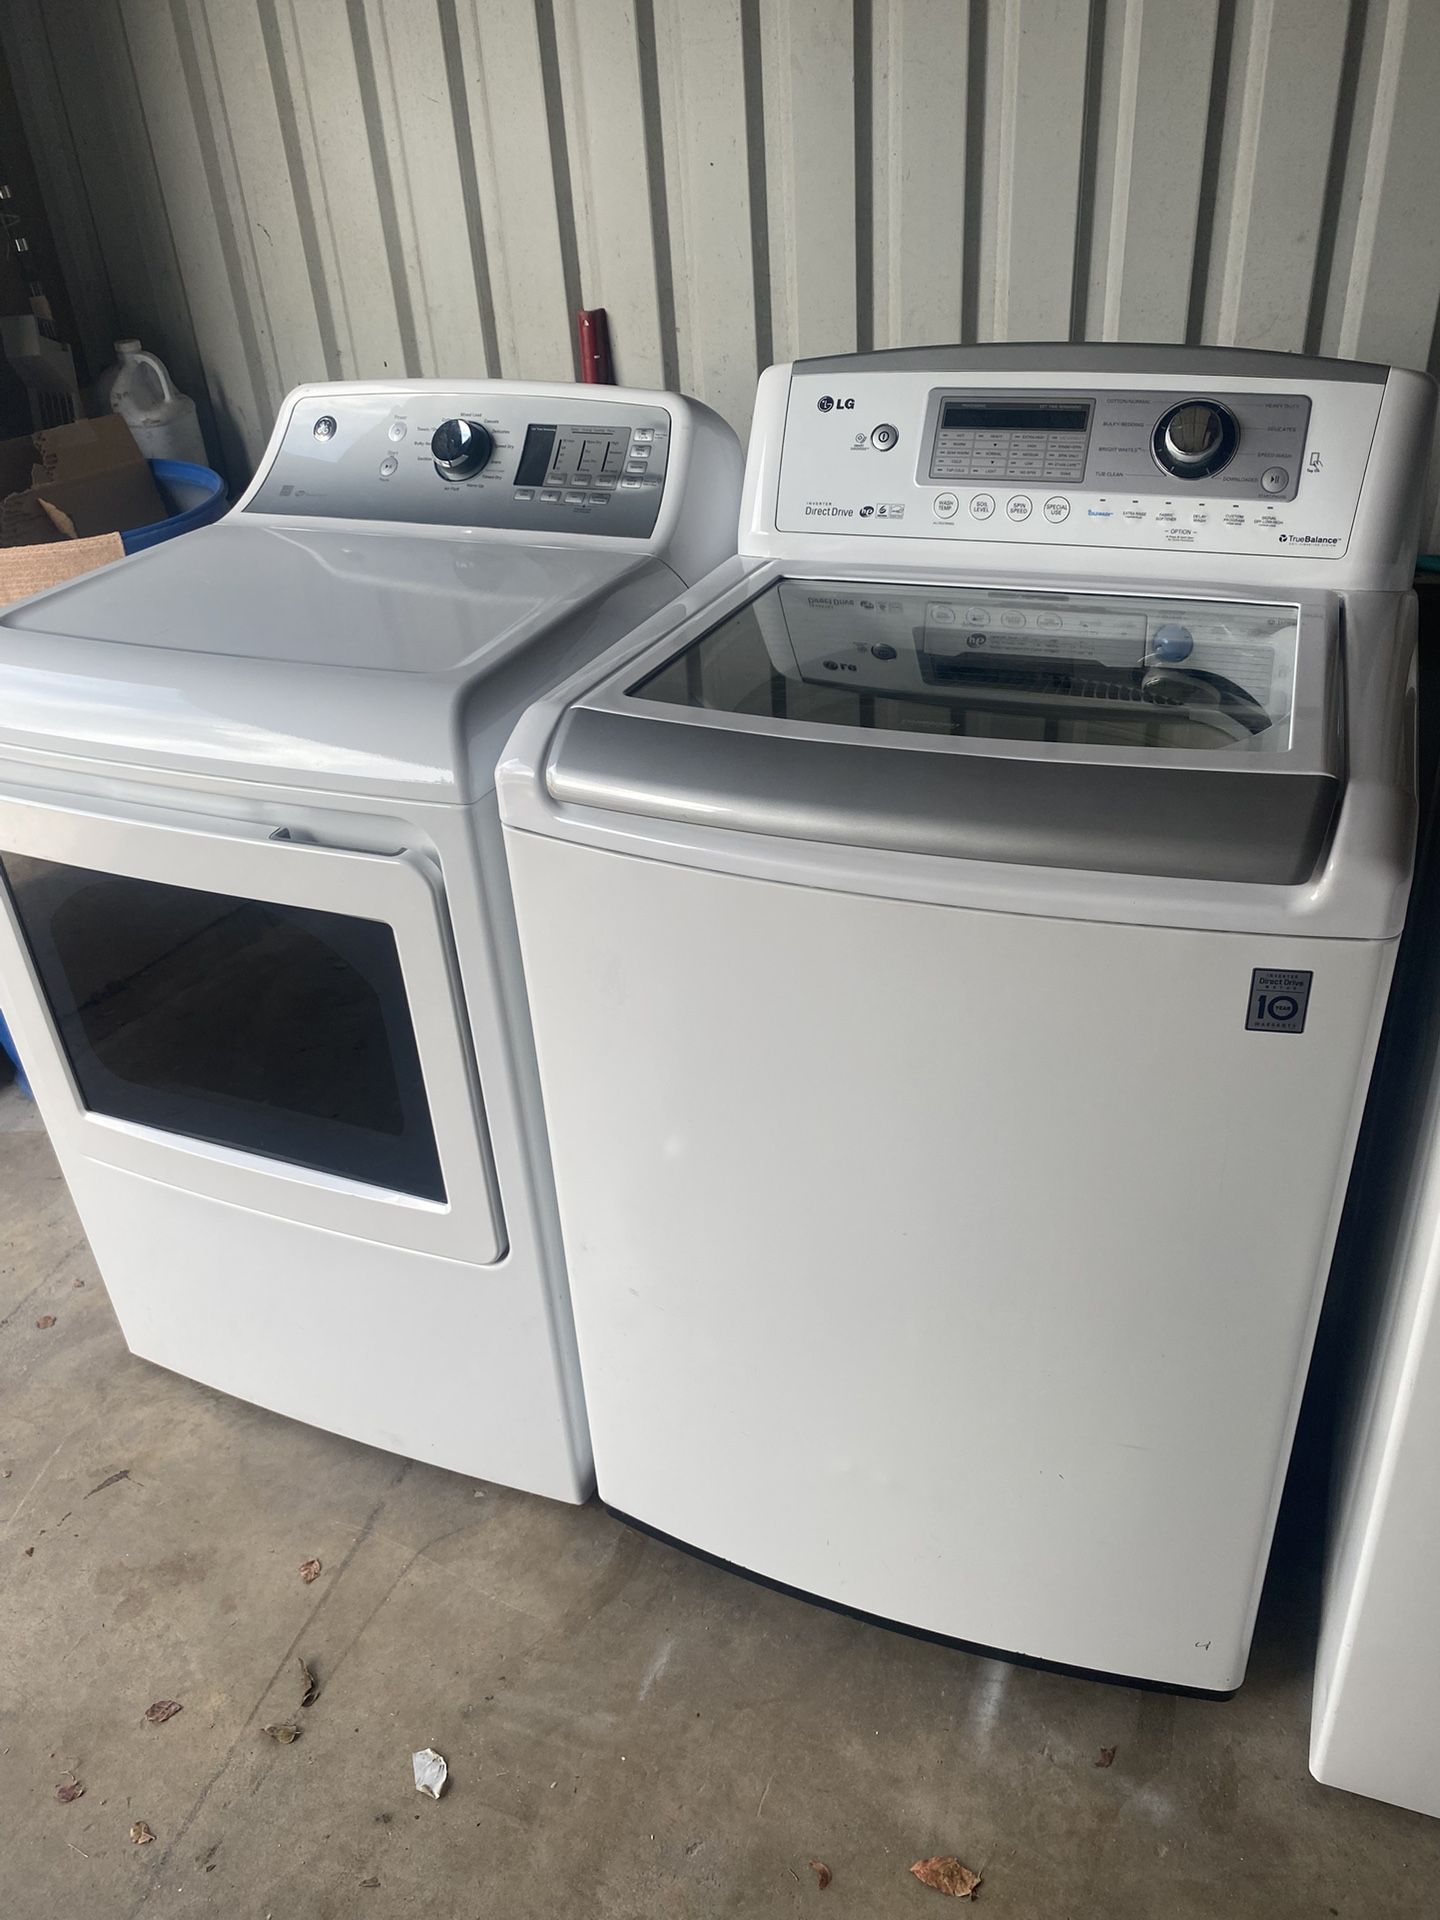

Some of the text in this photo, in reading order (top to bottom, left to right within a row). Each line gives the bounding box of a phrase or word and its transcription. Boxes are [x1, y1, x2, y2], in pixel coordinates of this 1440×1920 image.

[835, 398, 856, 410] LG
[804, 505, 855, 518] Direct Drive
[1046, 503, 1068, 511] SPECIAL
[1170, 527, 1192, 536] OPTION
[1259, 977, 1305, 987] Direct Drive
[1257, 995, 1299, 1022] 10
[1253, 1021, 1298, 1030] WARRANTY
